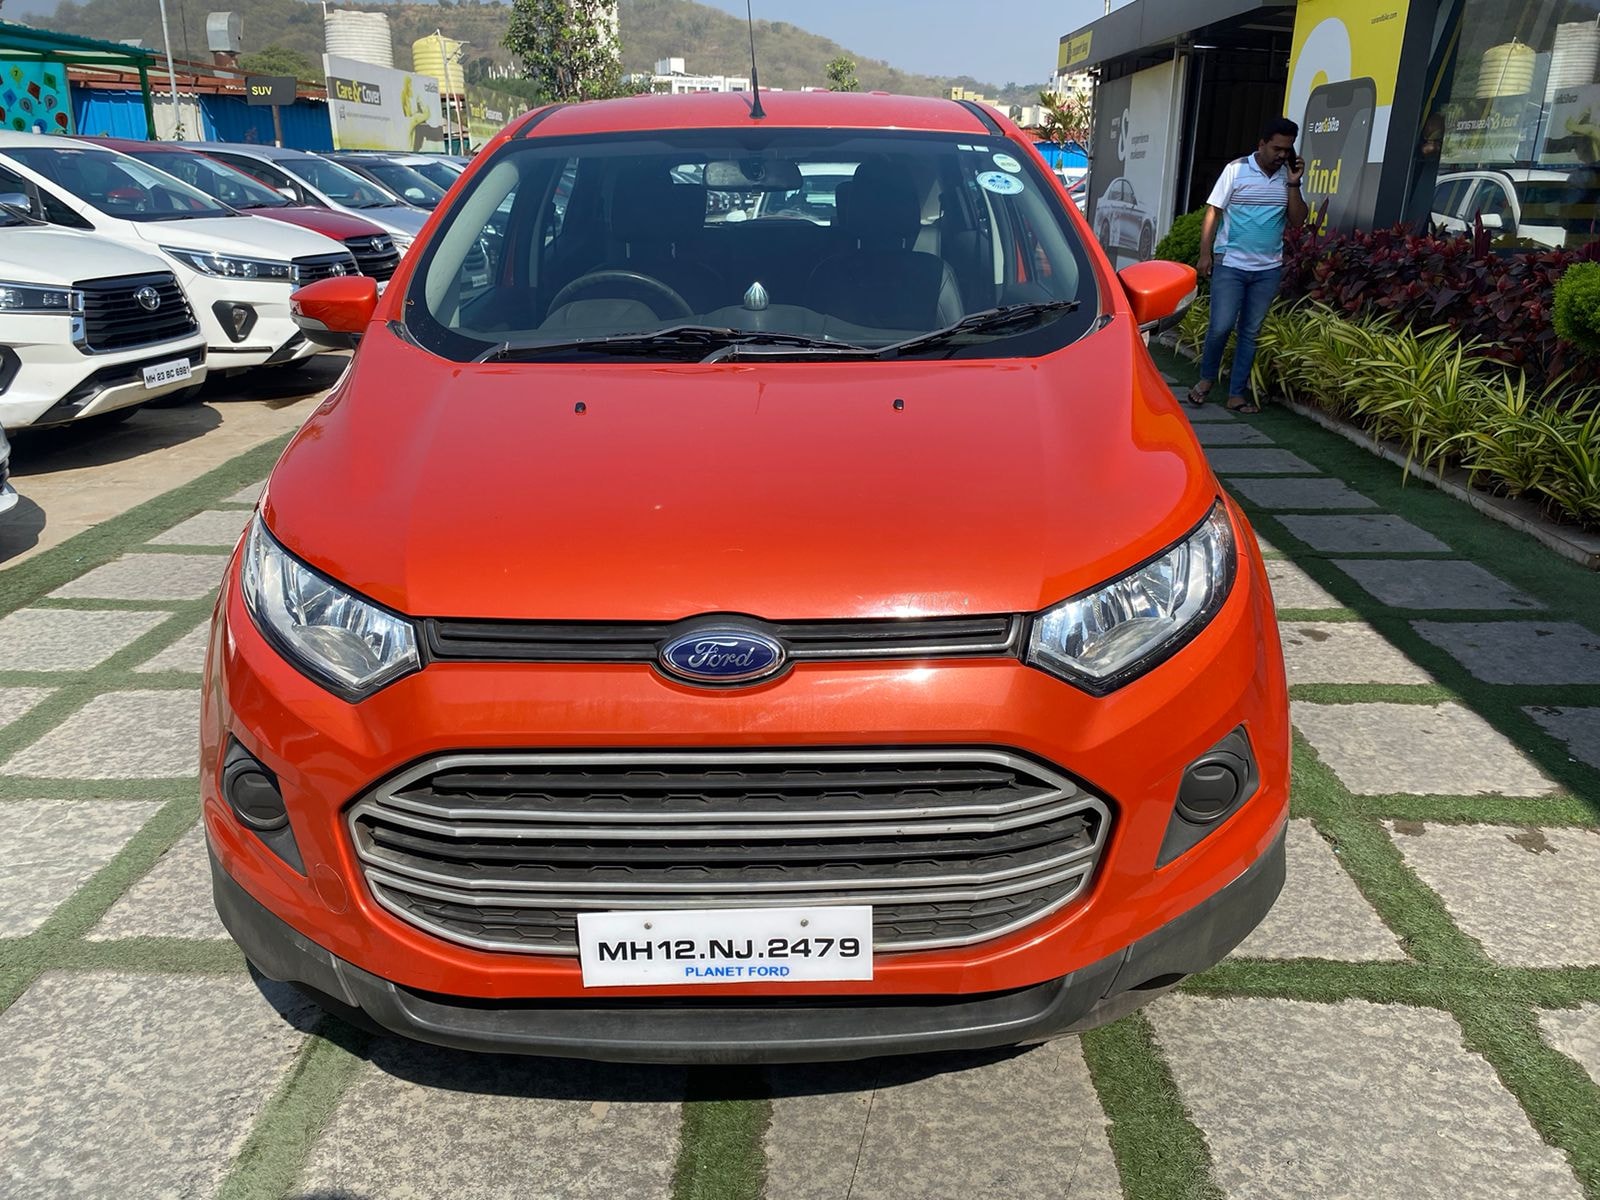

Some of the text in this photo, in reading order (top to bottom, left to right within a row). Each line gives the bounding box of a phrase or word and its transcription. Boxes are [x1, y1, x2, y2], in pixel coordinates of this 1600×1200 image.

[251, 86, 272, 95] SUV
[336, 80, 381, 104] Care & Cover
[1307, 159, 1342, 194] find
[146, 374, 156, 384] MH
[157, 371, 165, 381] 23
[688, 641, 754, 668] Ford
[598, 938, 860, 961] MH12.NJ.2479
[685, 966, 790, 978] PLANET FORD
